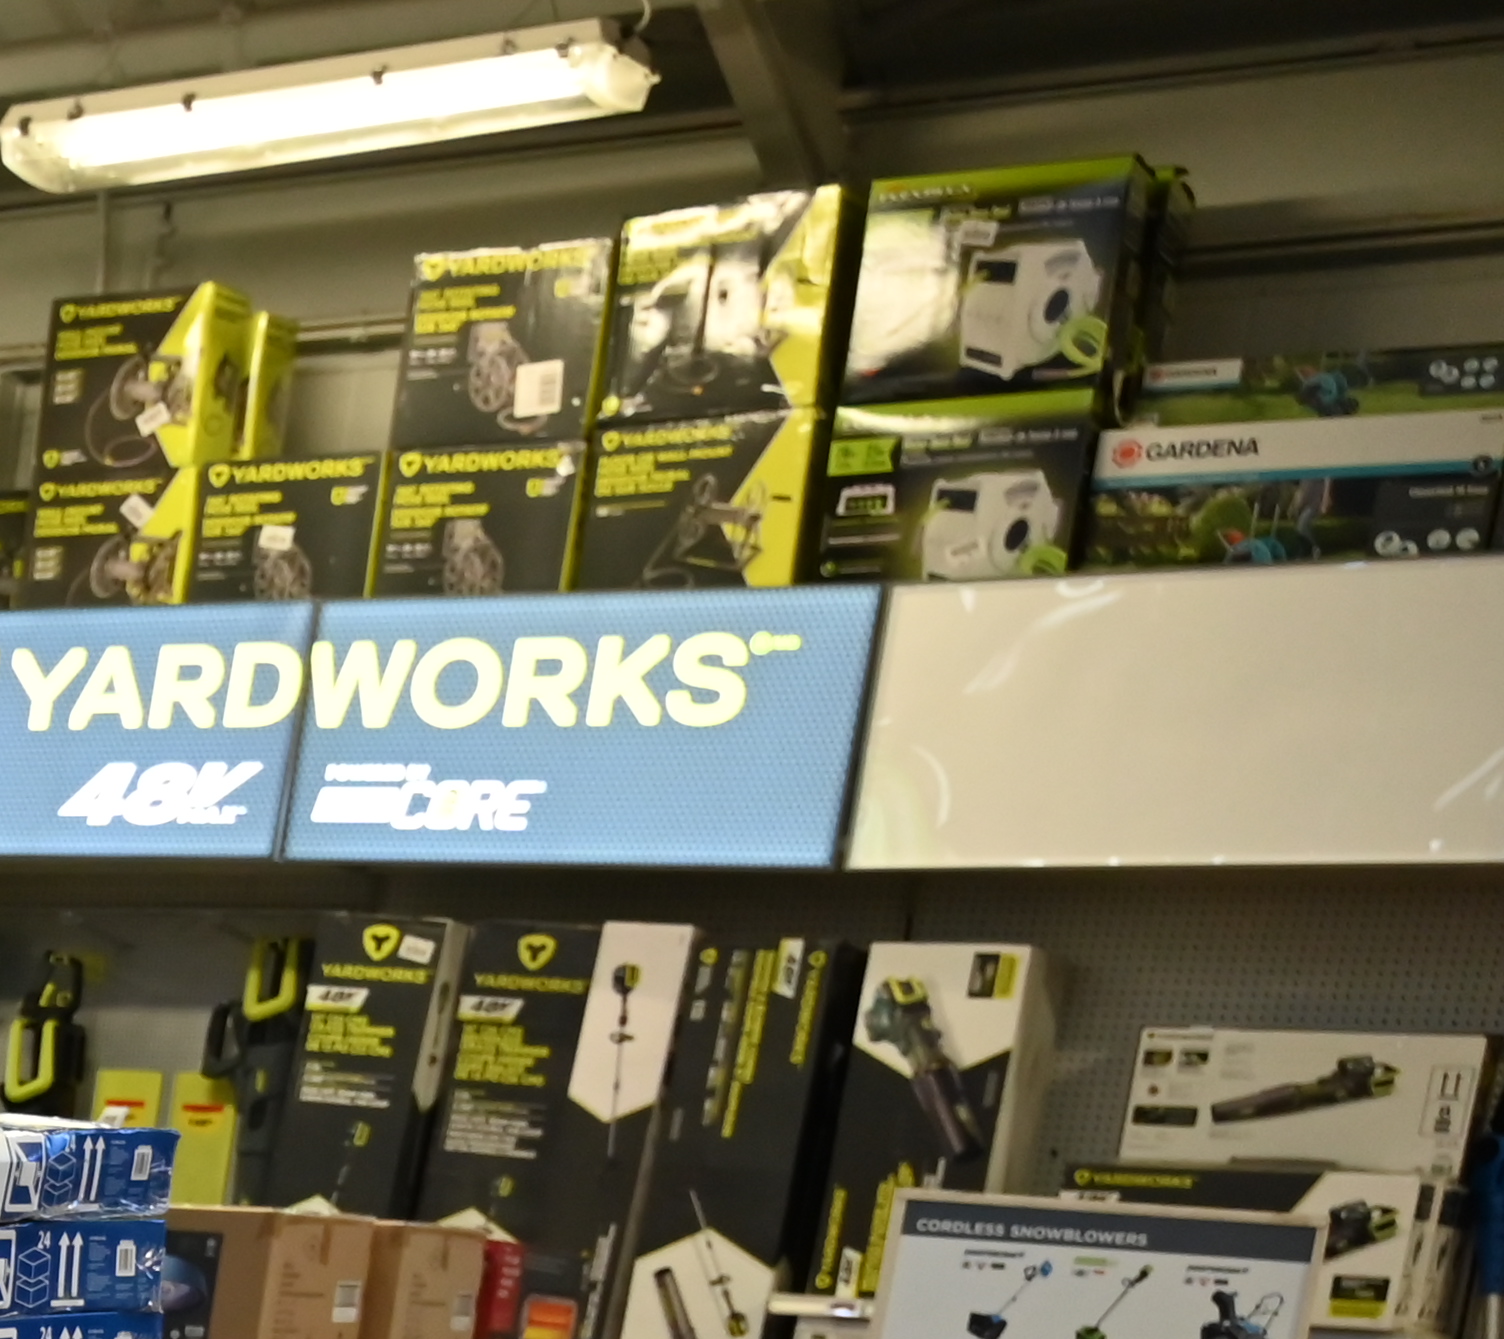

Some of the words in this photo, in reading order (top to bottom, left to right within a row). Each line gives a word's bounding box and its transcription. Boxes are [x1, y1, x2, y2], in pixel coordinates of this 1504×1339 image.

[1145, 437, 1261, 462] GARDENA
[233, 457, 360, 486] YARDWORKS
[10, 632, 750, 732] YARDWORKS
[321, 961, 428, 985] YARDWORKS
[474, 972, 585, 995] YARDWORKS
[916, 1217, 1006, 1237] CORDLESS
[1010, 1222, 1149, 1248] SNOWBLOWERS
